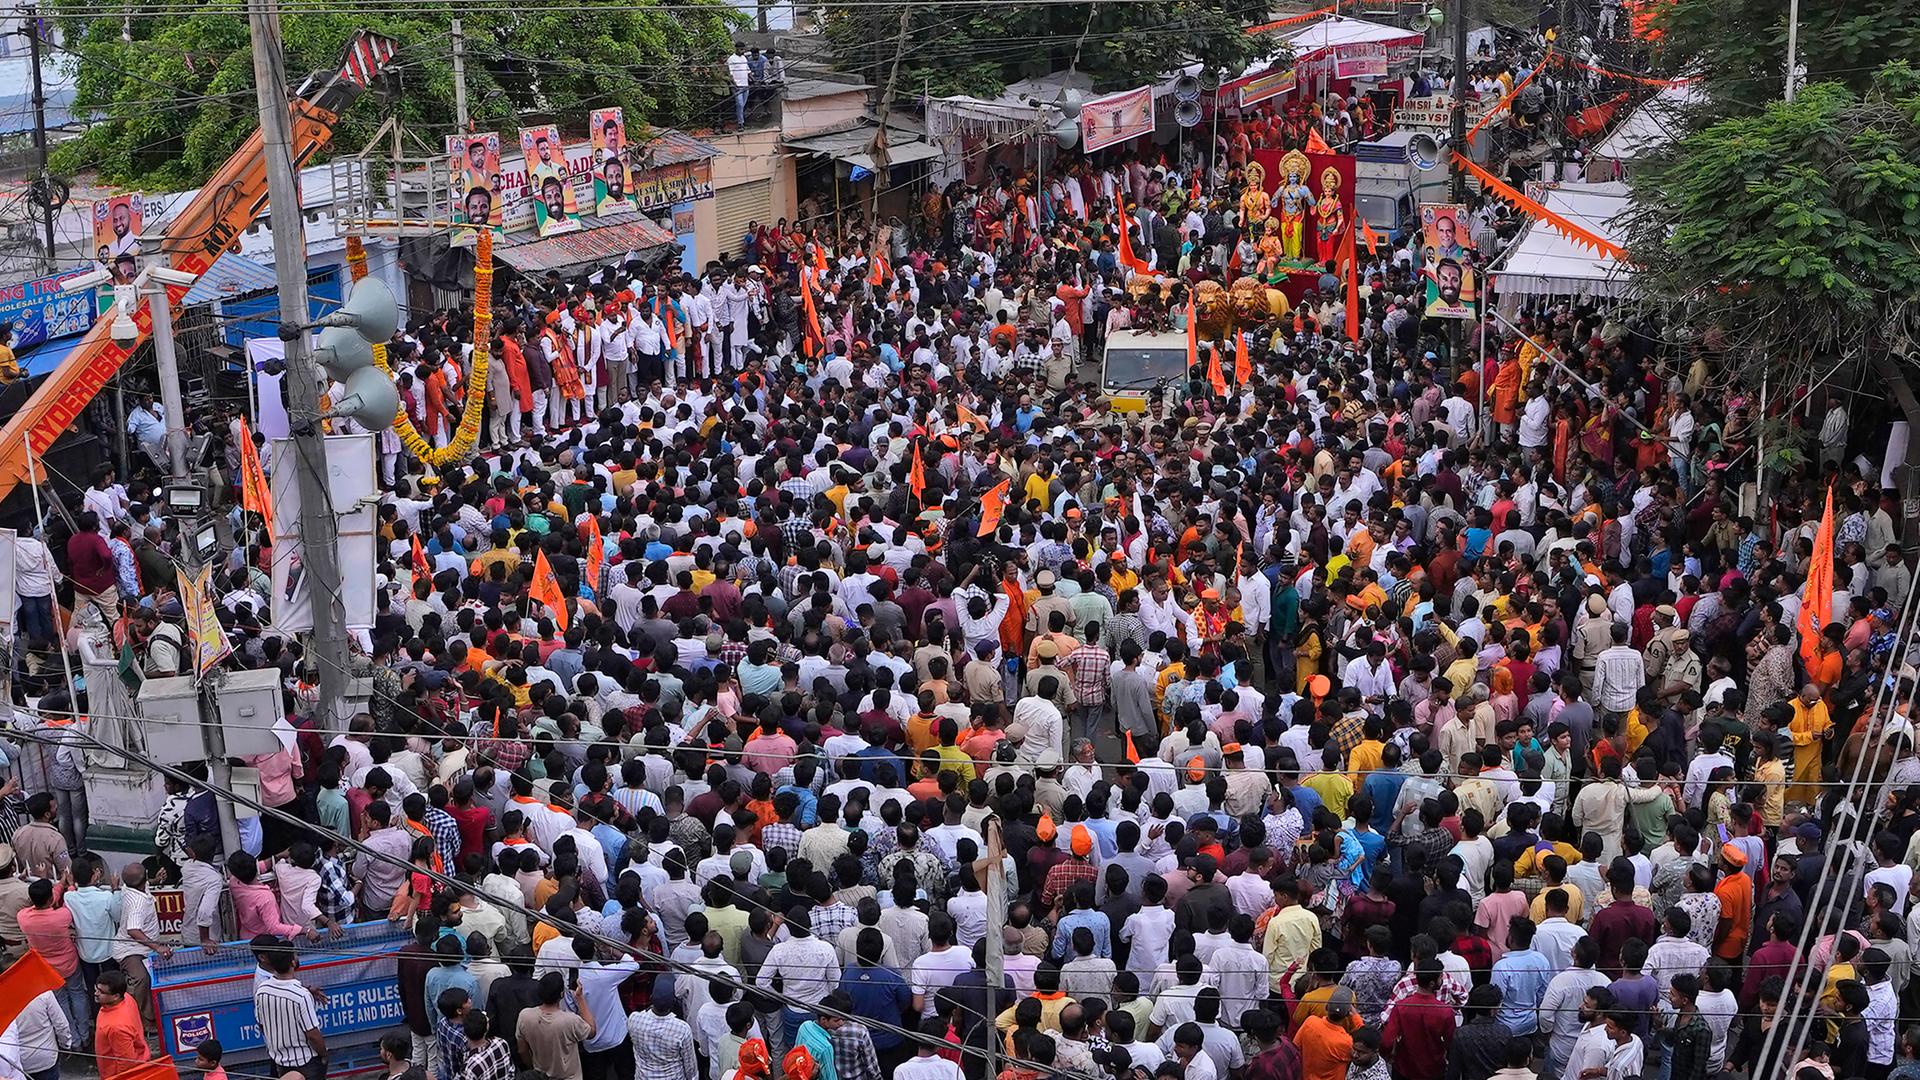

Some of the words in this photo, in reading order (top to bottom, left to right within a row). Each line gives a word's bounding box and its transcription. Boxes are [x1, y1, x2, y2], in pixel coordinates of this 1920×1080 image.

[143, 201, 164, 219] ERS
[29, 337, 139, 456] HYDERABA
[357, 984, 400, 1005] RULES
[332, 1009, 354, 1027] LIFE
[357, 1005, 378, 1023] AND
[182, 1029, 208, 1038] POLICE
